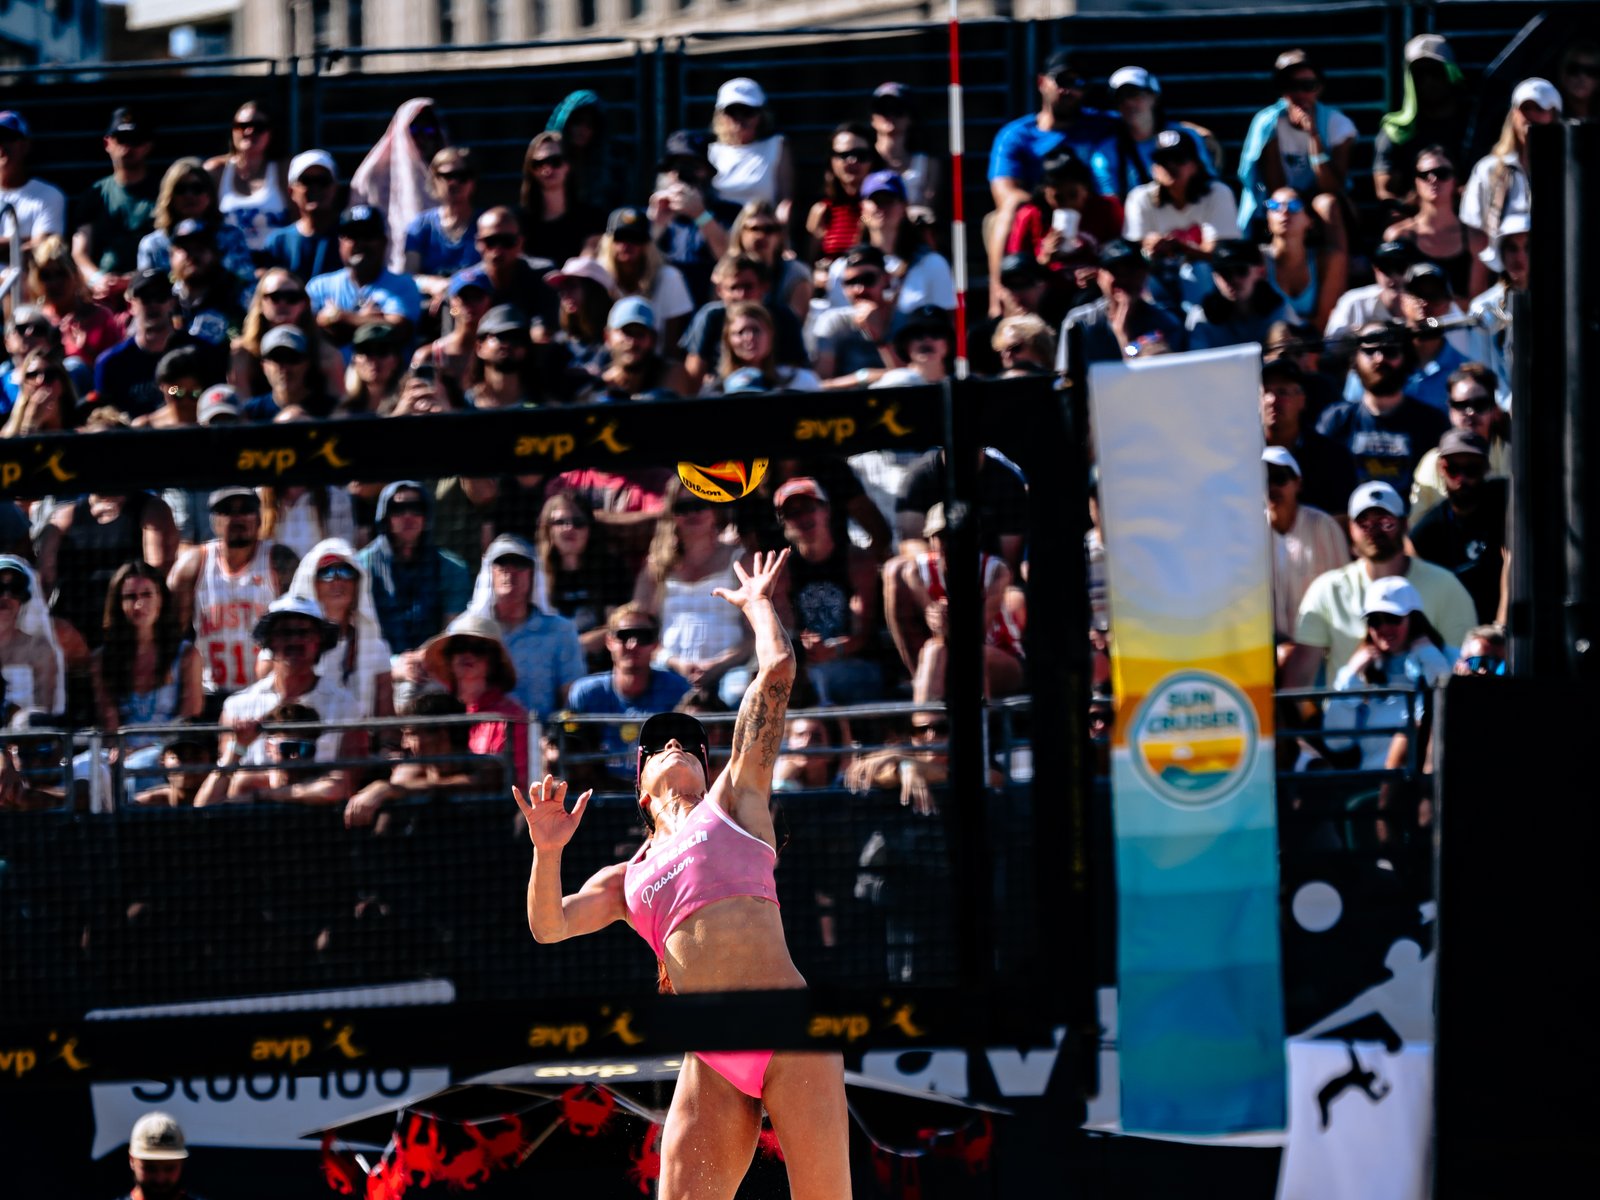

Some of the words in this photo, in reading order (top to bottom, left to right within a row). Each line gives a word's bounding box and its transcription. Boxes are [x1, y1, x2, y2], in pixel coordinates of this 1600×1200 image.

[796, 417, 855, 442] avp
[514, 433, 574, 460] avp
[238, 448, 296, 473] avp
[682, 476, 722, 497] Wilson
[641, 856, 695, 908] Passion
[528, 1025, 589, 1051] avp
[808, 1015, 869, 1041] avp
[251, 1037, 311, 1064] avp
[0, 1050, 36, 1078] vp
[534, 1064, 638, 1078] avp
